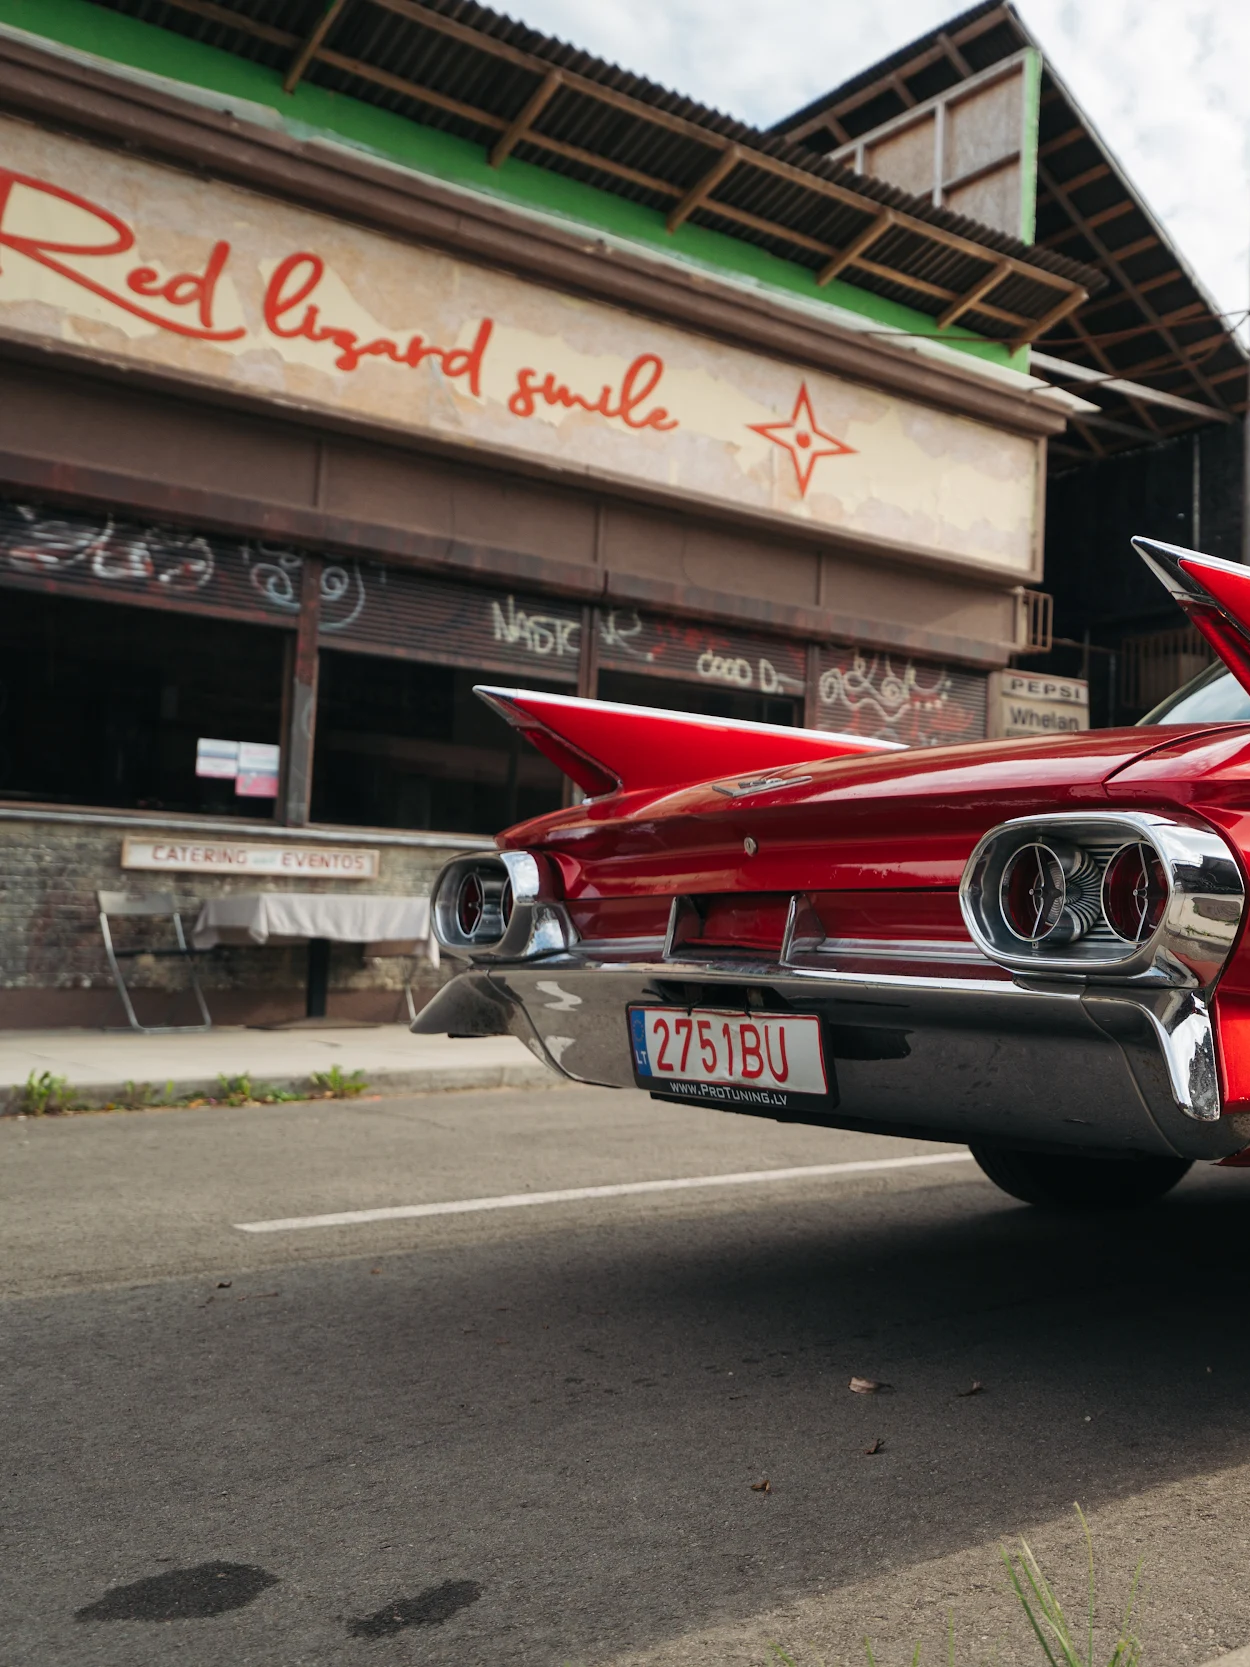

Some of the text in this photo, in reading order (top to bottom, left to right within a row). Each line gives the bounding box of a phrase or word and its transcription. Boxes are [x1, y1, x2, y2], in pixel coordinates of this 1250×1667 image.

[0, 166, 679, 431] Red lizard smile
[1011, 678, 1081, 699] PEPSI
[1009, 704, 1080, 732] Whelan
[152, 845, 247, 865] CATERING
[281, 852, 365, 870] EVENTOS
[635, 1050, 648, 1065] LT
[653, 1017, 790, 1083] 2751BU
